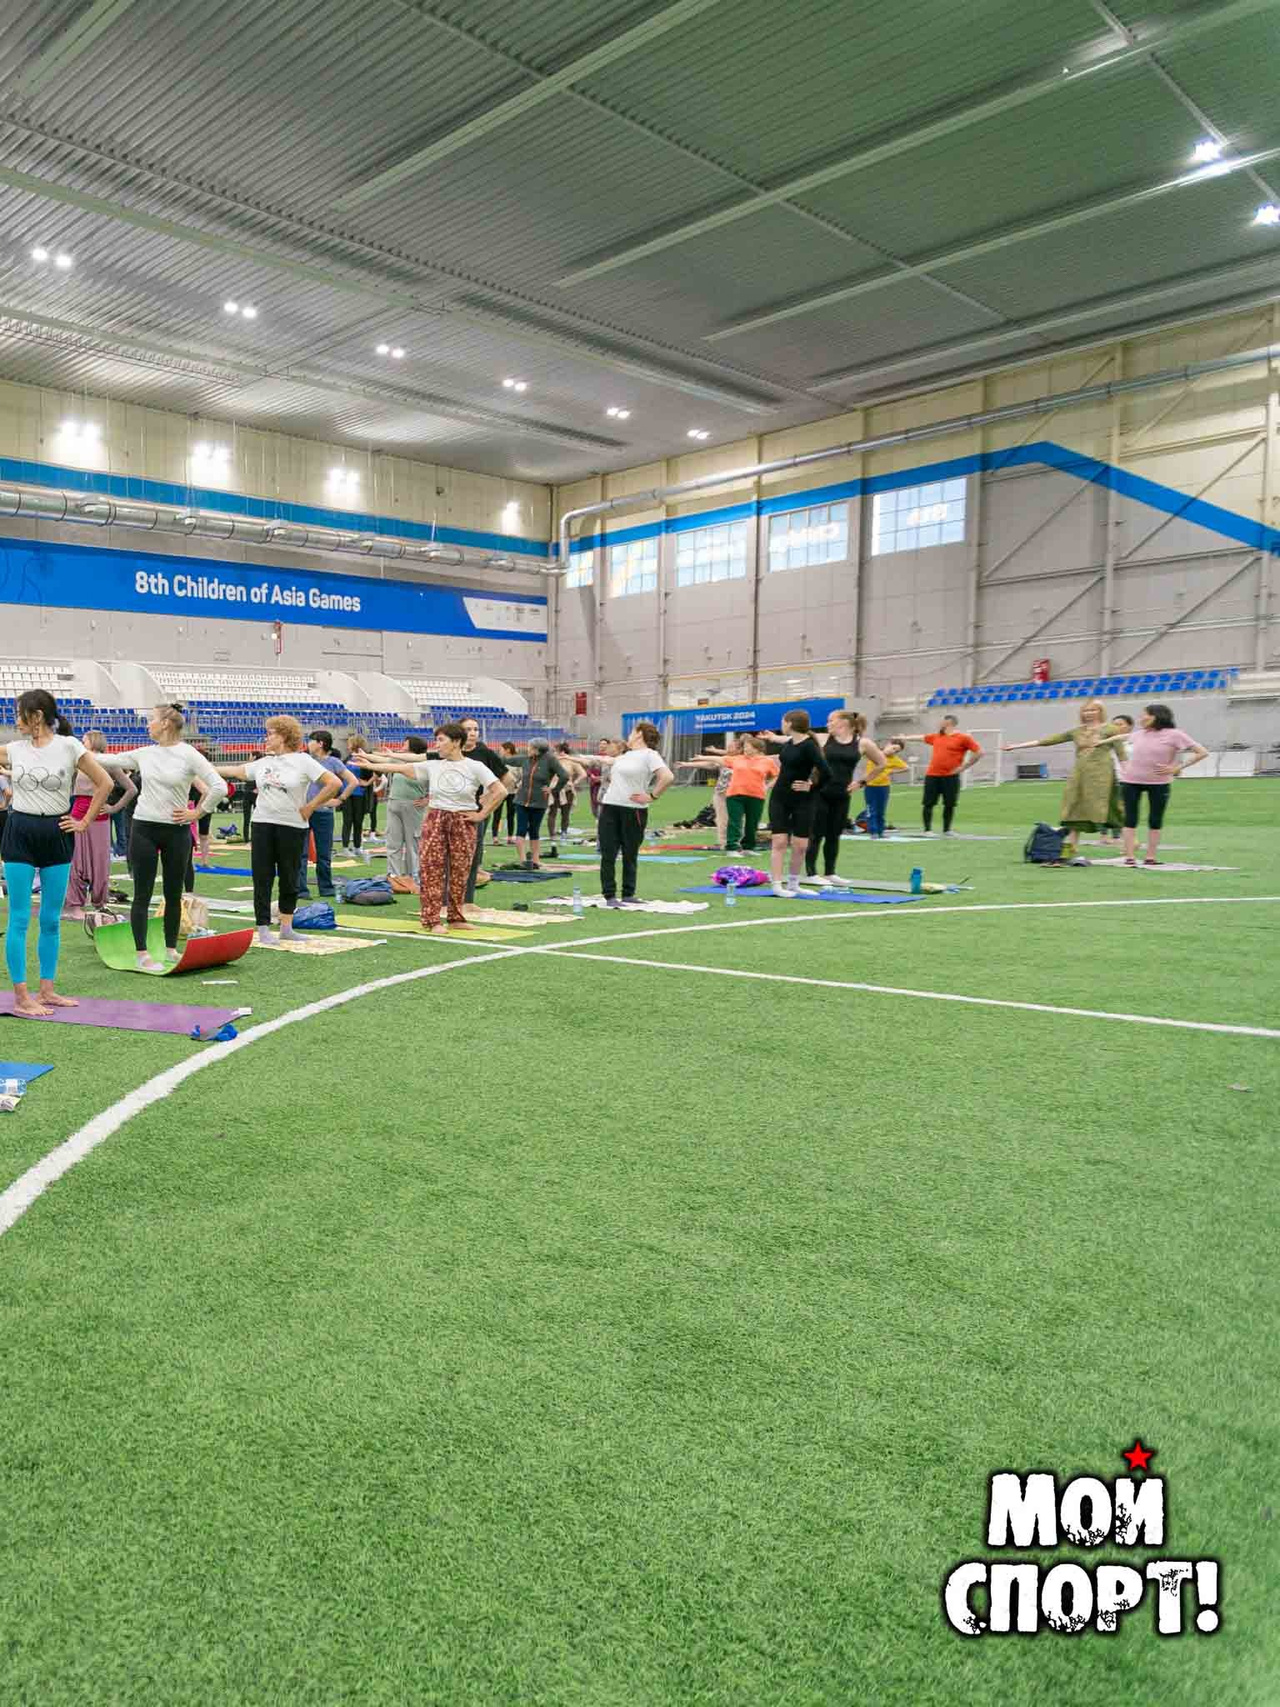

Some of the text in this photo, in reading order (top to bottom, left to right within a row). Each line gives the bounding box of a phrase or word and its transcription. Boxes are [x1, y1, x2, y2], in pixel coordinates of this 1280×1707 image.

[135, 571, 361, 612] 8th Children of Asia Games
